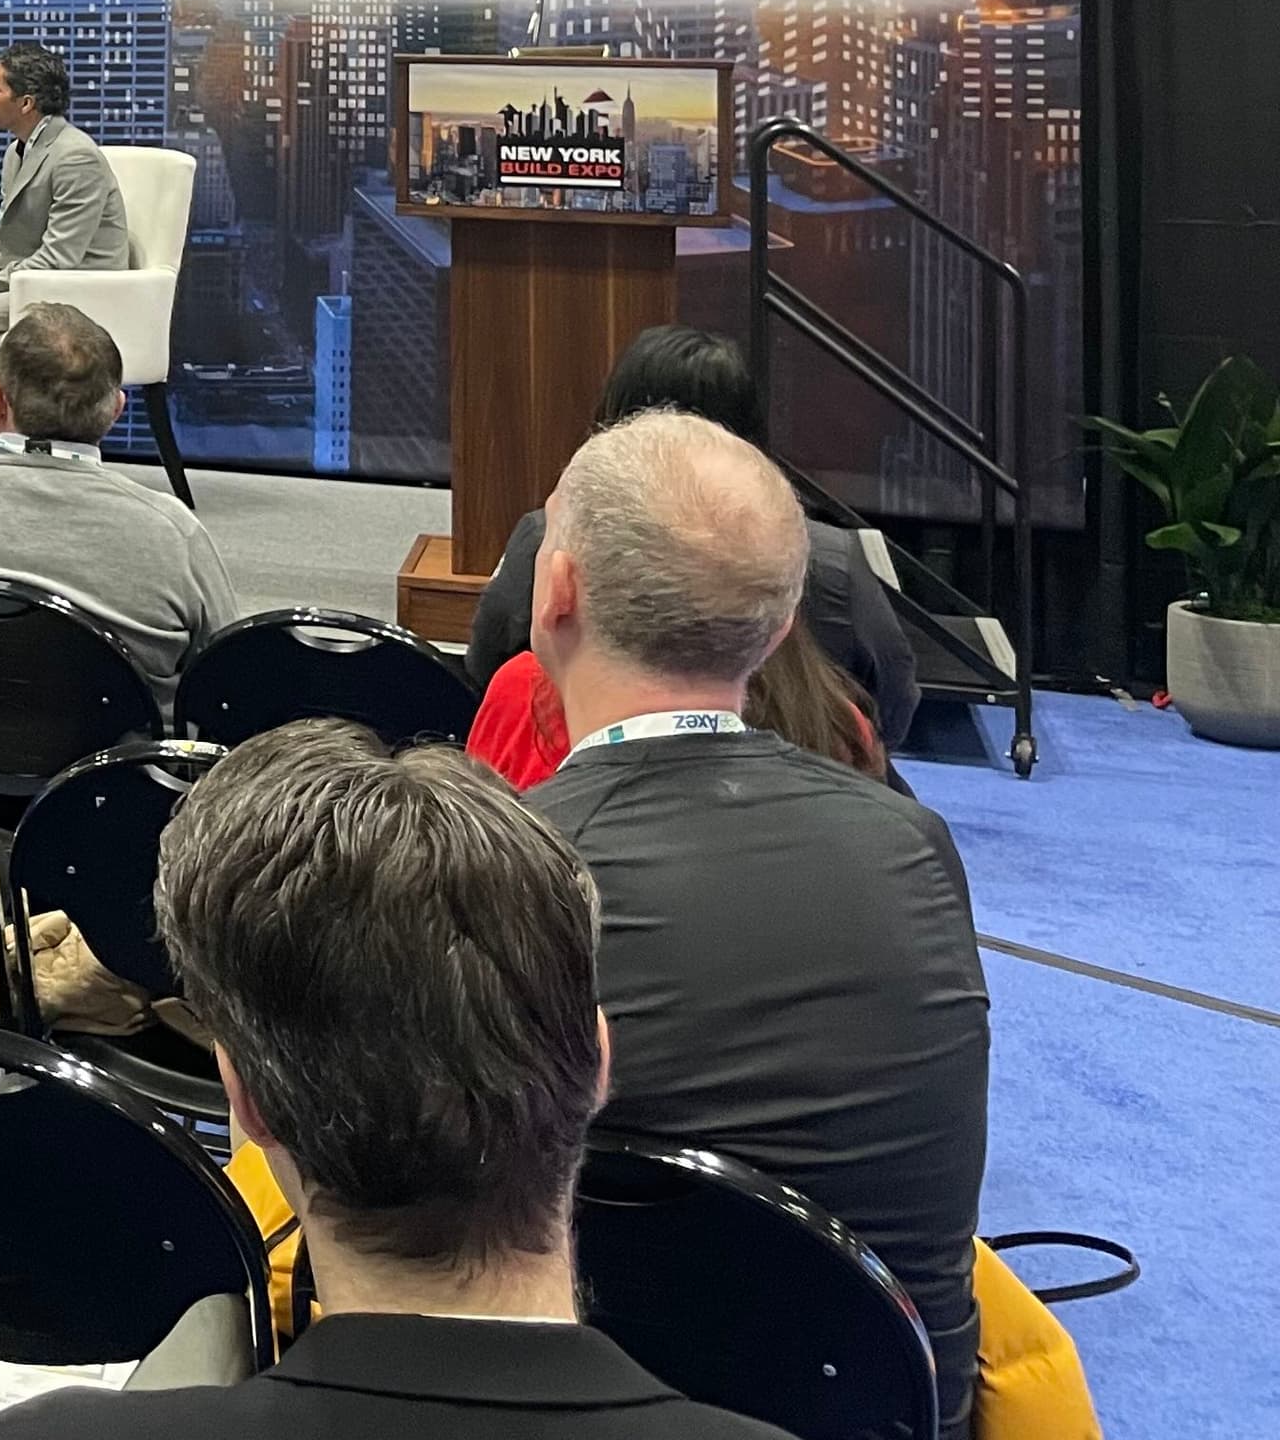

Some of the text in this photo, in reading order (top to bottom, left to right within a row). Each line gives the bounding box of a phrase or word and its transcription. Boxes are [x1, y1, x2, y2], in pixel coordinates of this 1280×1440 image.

[500, 145, 621, 164] NEW YORK
[500, 161, 621, 177] BUILD EXPO
